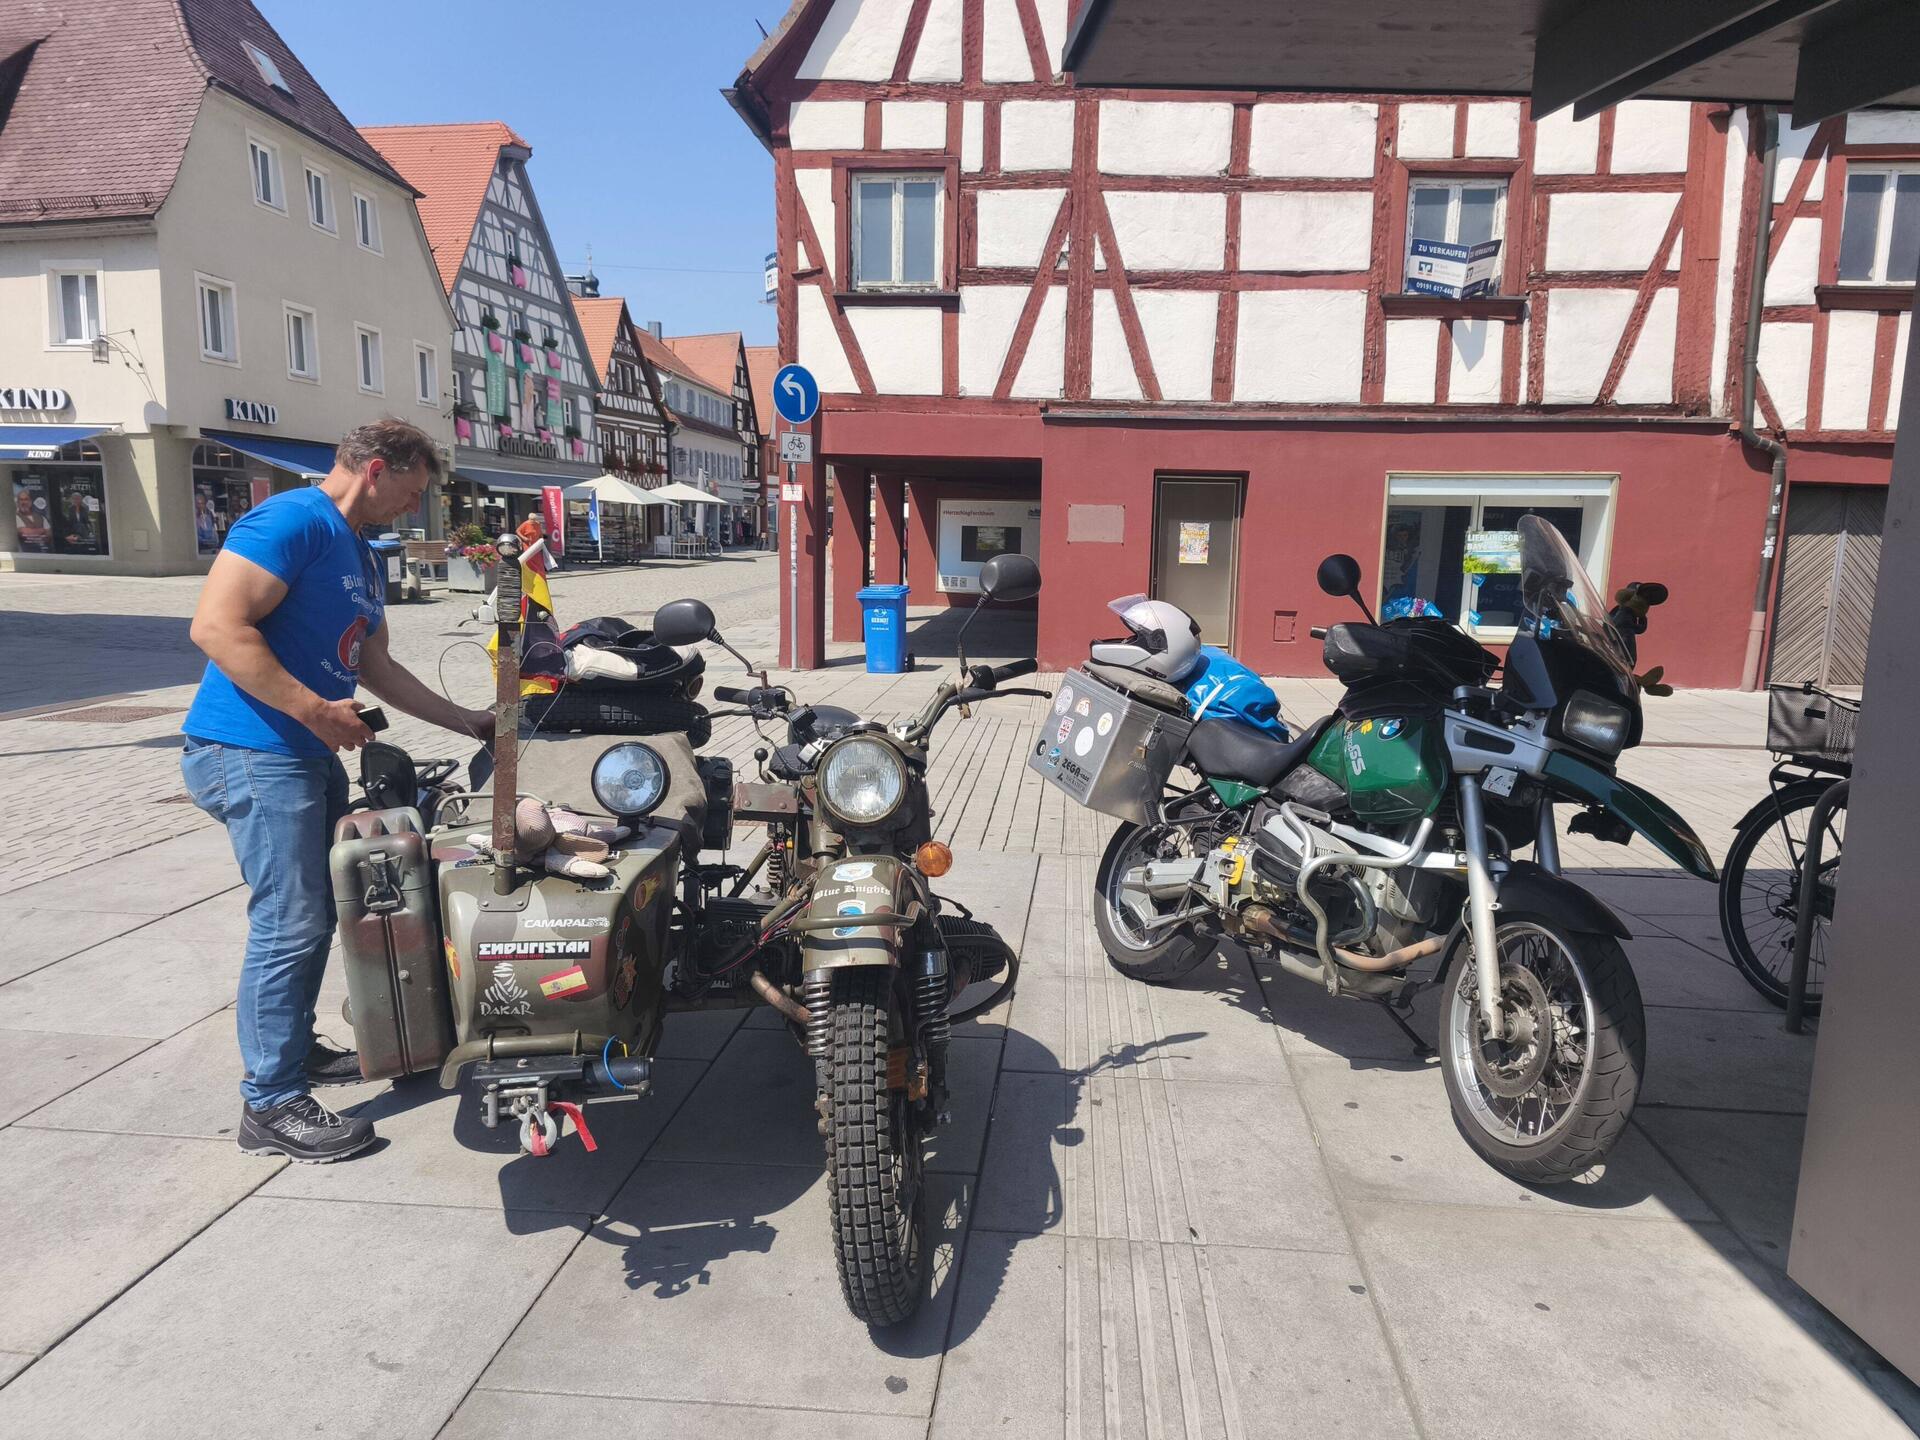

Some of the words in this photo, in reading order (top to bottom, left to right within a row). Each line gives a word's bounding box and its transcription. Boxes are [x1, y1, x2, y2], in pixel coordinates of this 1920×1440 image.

[1418, 244, 1428, 252] ZU
[1429, 246, 1467, 259] VERKAUFEN
[1416, 282, 1432, 290] 09191
[0, 388, 66, 410] KIND
[231, 399, 278, 425] KIND
[27, 450, 53, 459] KIND
[813, 888, 841, 900] Blue
[843, 884, 891, 896] Knights
[479, 941, 590, 955] ENDURISTAN
[479, 1001, 535, 1016] DAKAR
